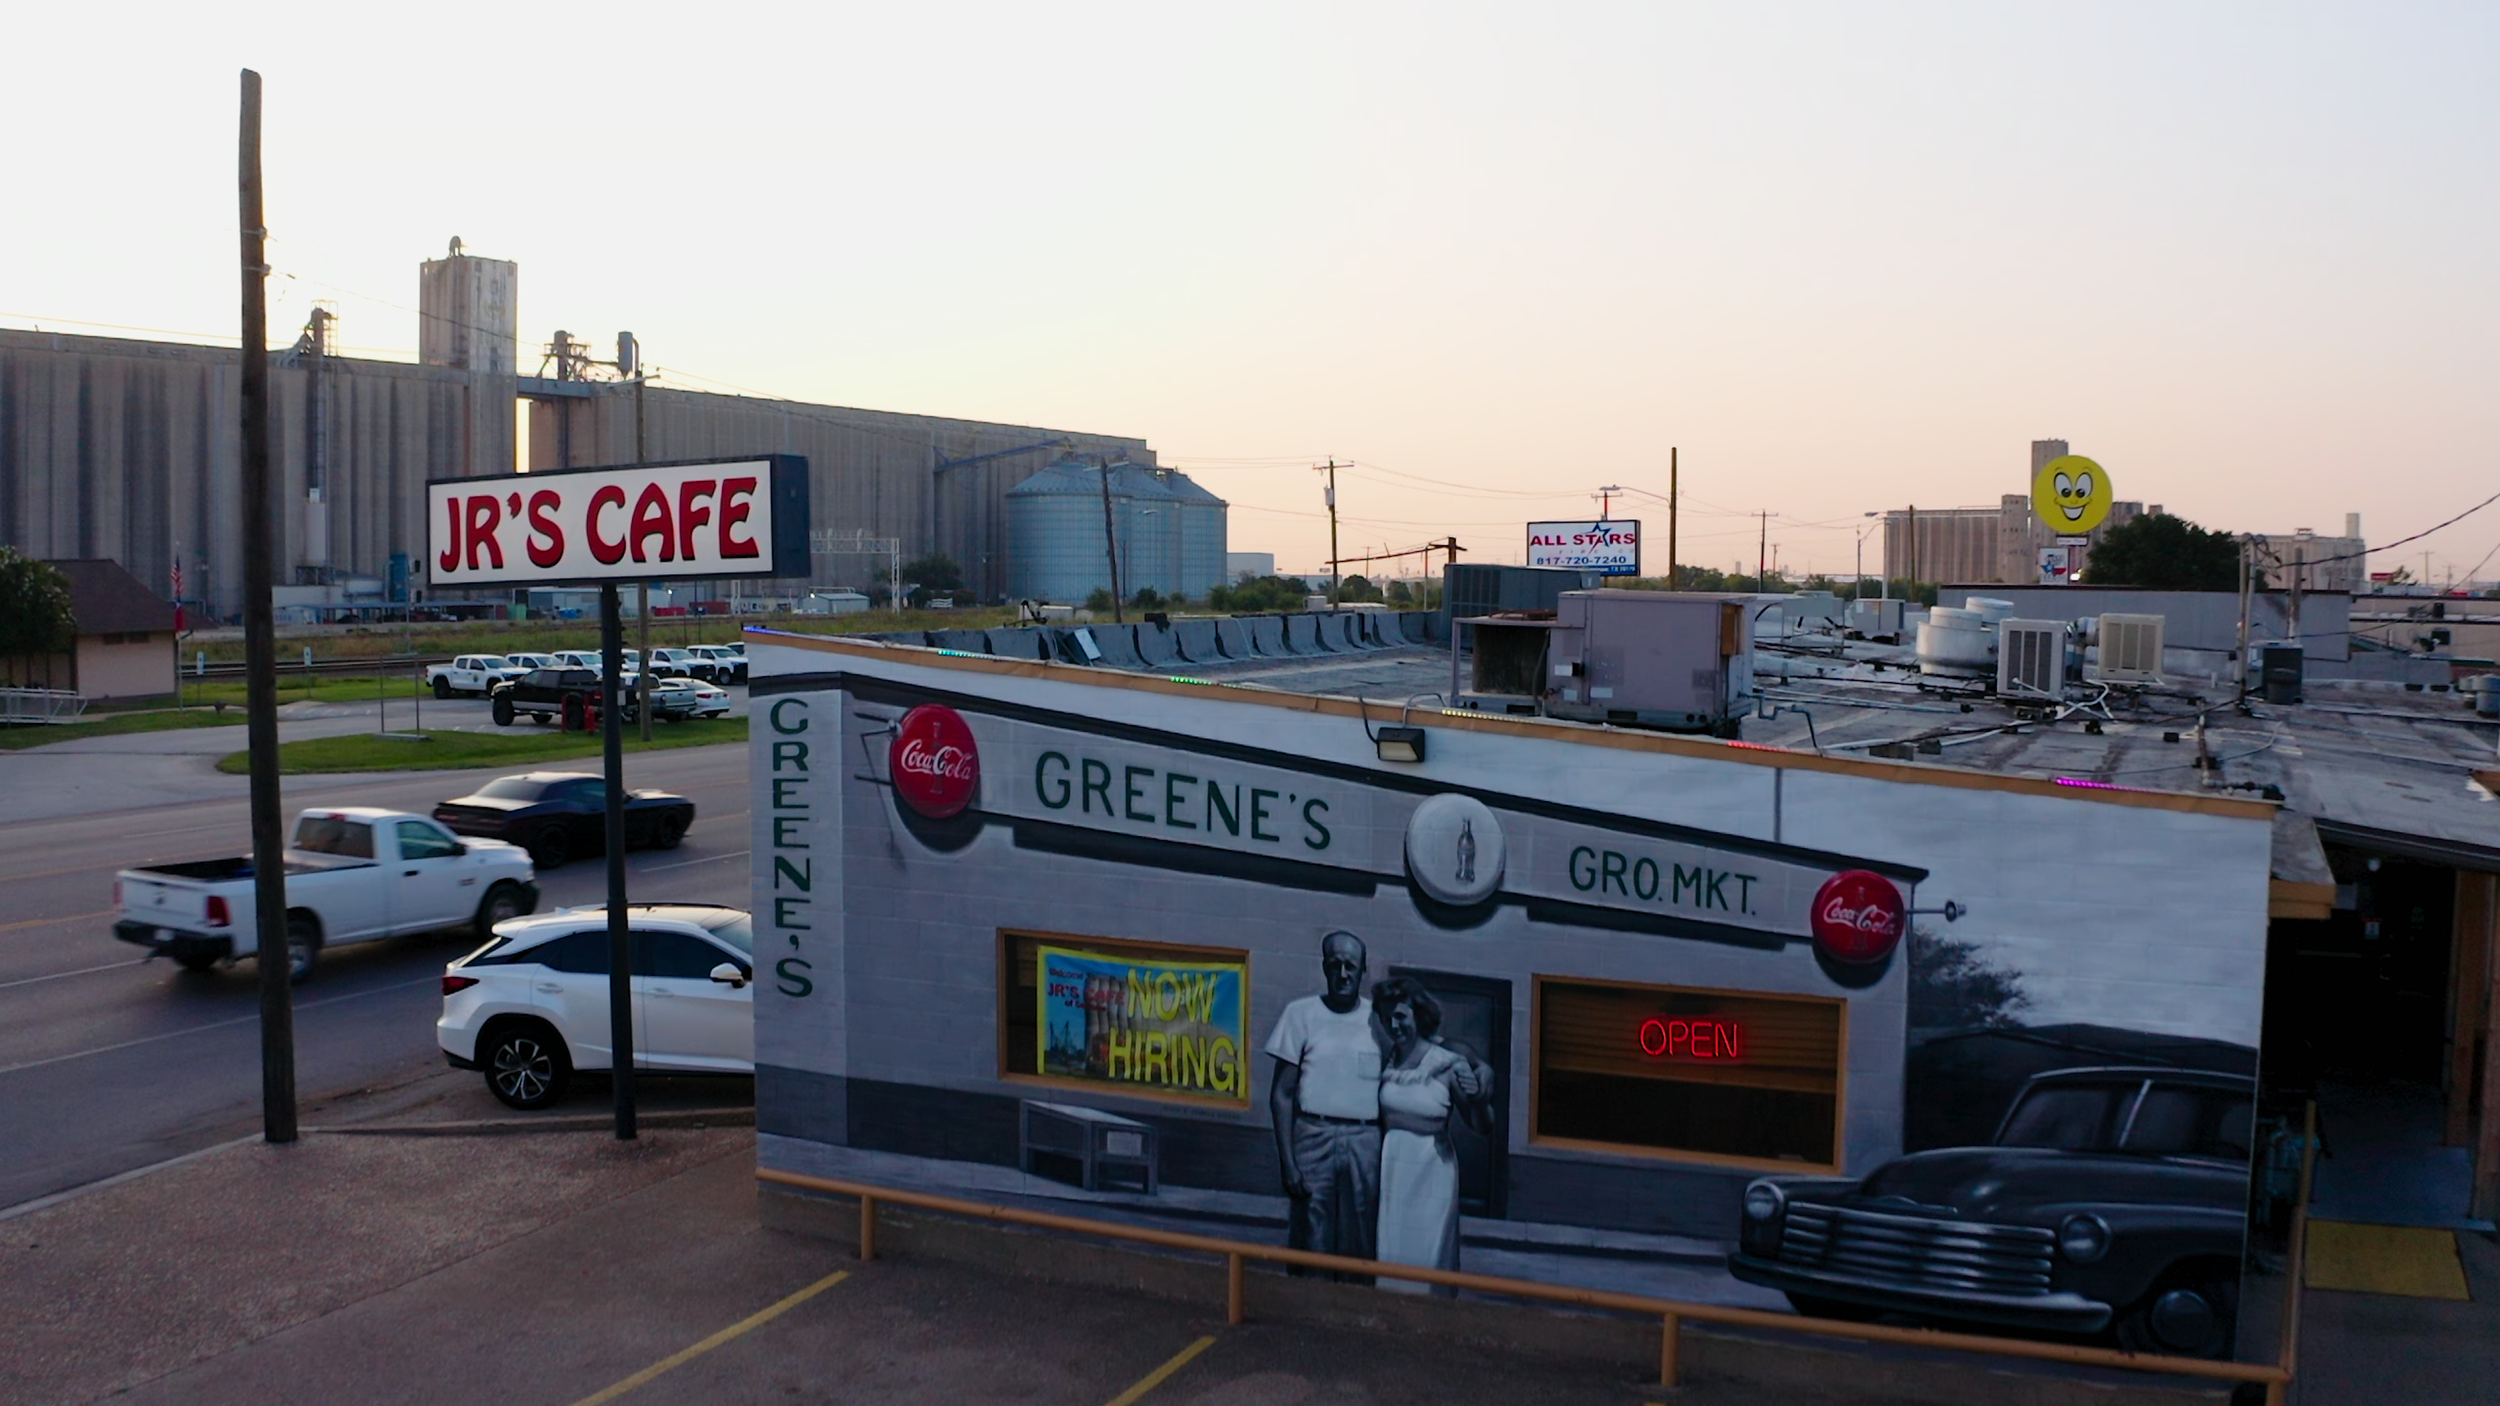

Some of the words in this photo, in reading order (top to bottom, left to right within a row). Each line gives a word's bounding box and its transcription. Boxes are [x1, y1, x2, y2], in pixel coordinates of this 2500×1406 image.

[440, 490, 564, 573] JR'S
[586, 477, 759, 565] CAFE
[1530, 535, 1567, 546] ALL
[1573, 532, 1636, 547] STARS
[1536, 556, 1627, 566] 817-720-7240
[1035, 751, 1331, 850] GREENE'S
[770, 698, 813, 998] GREENE'S
[1128, 967, 1218, 1024] NOW
[1108, 1027, 1235, 1092] HIRING
[1639, 1019, 1738, 1058] OPEN
